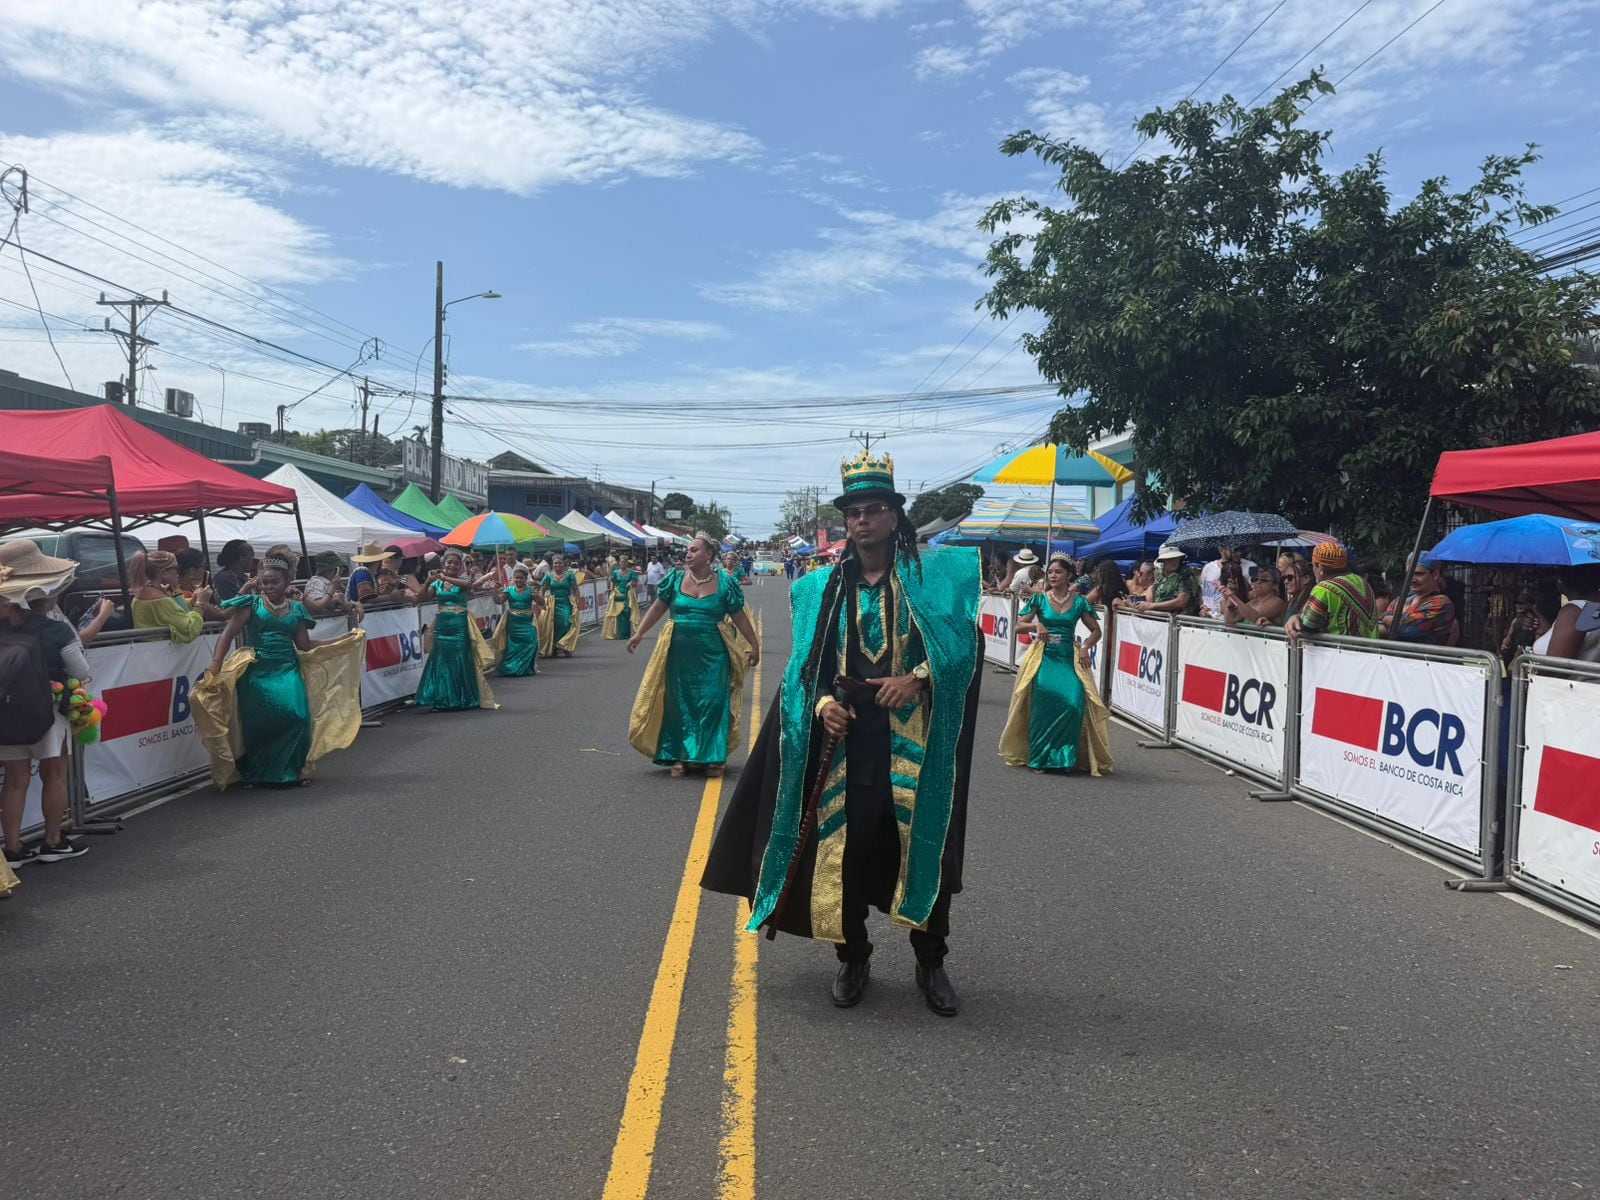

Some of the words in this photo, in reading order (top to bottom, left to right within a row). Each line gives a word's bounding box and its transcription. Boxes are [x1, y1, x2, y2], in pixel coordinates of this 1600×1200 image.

[406, 440, 432, 478] BLAC
[444, 457, 462, 489] AND
[399, 630, 421, 663] BC
[994, 615, 1008, 639] BCR
[1139, 646, 1163, 685] BCR
[1224, 673, 1276, 730] BCR
[138, 733, 162, 748] SOMOS
[172, 725, 193, 738] BANCO
[1222, 719, 1238, 732] BANCO
[1239, 724, 1244, 734] DE
[1246, 727, 1260, 739] COSTA
[1261, 732, 1273, 743] RICA
[1382, 701, 1465, 777] BCR
[1343, 750, 1369, 766] SOMOS
[1369, 758, 1376, 769] EL
[1380, 761, 1405, 778] BANCO
[1406, 769, 1417, 782] DE
[1417, 773, 1443, 790] COSTA
[1444, 781, 1463, 797] RICA
